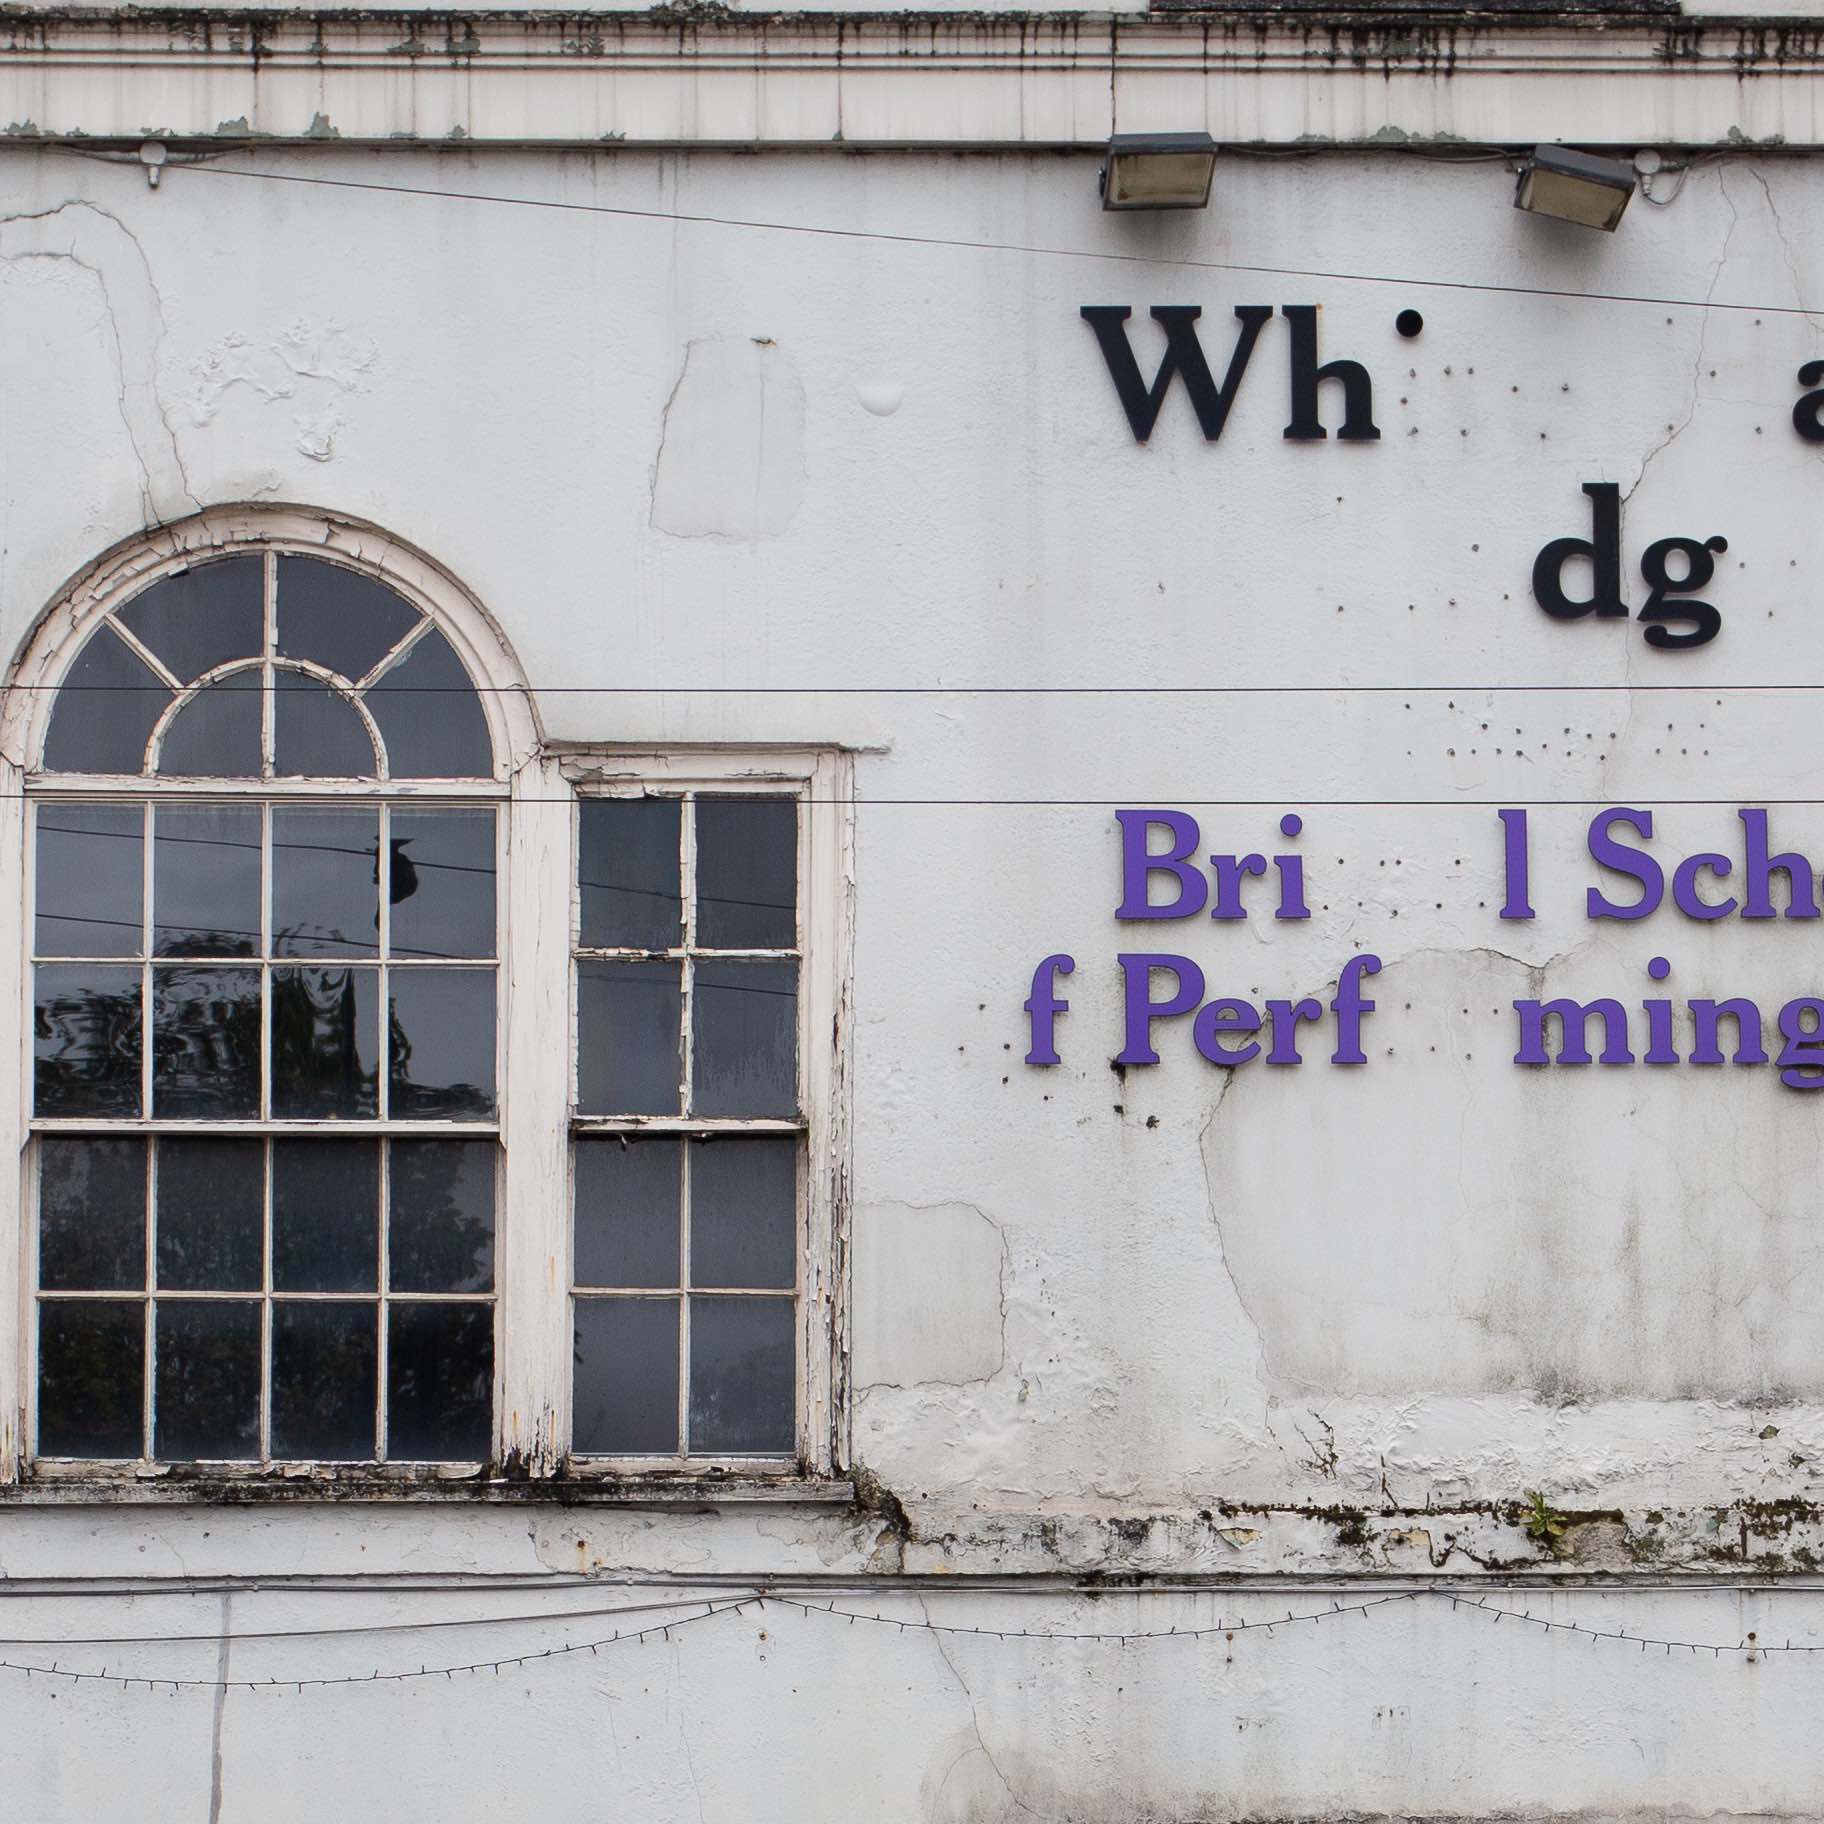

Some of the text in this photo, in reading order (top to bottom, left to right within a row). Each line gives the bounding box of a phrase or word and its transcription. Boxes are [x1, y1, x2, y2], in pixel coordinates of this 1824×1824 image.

[1531, 483, 1729, 650] dg
[1115, 808, 1310, 921] Bri
[1118, 953, 1382, 1066] Perf
